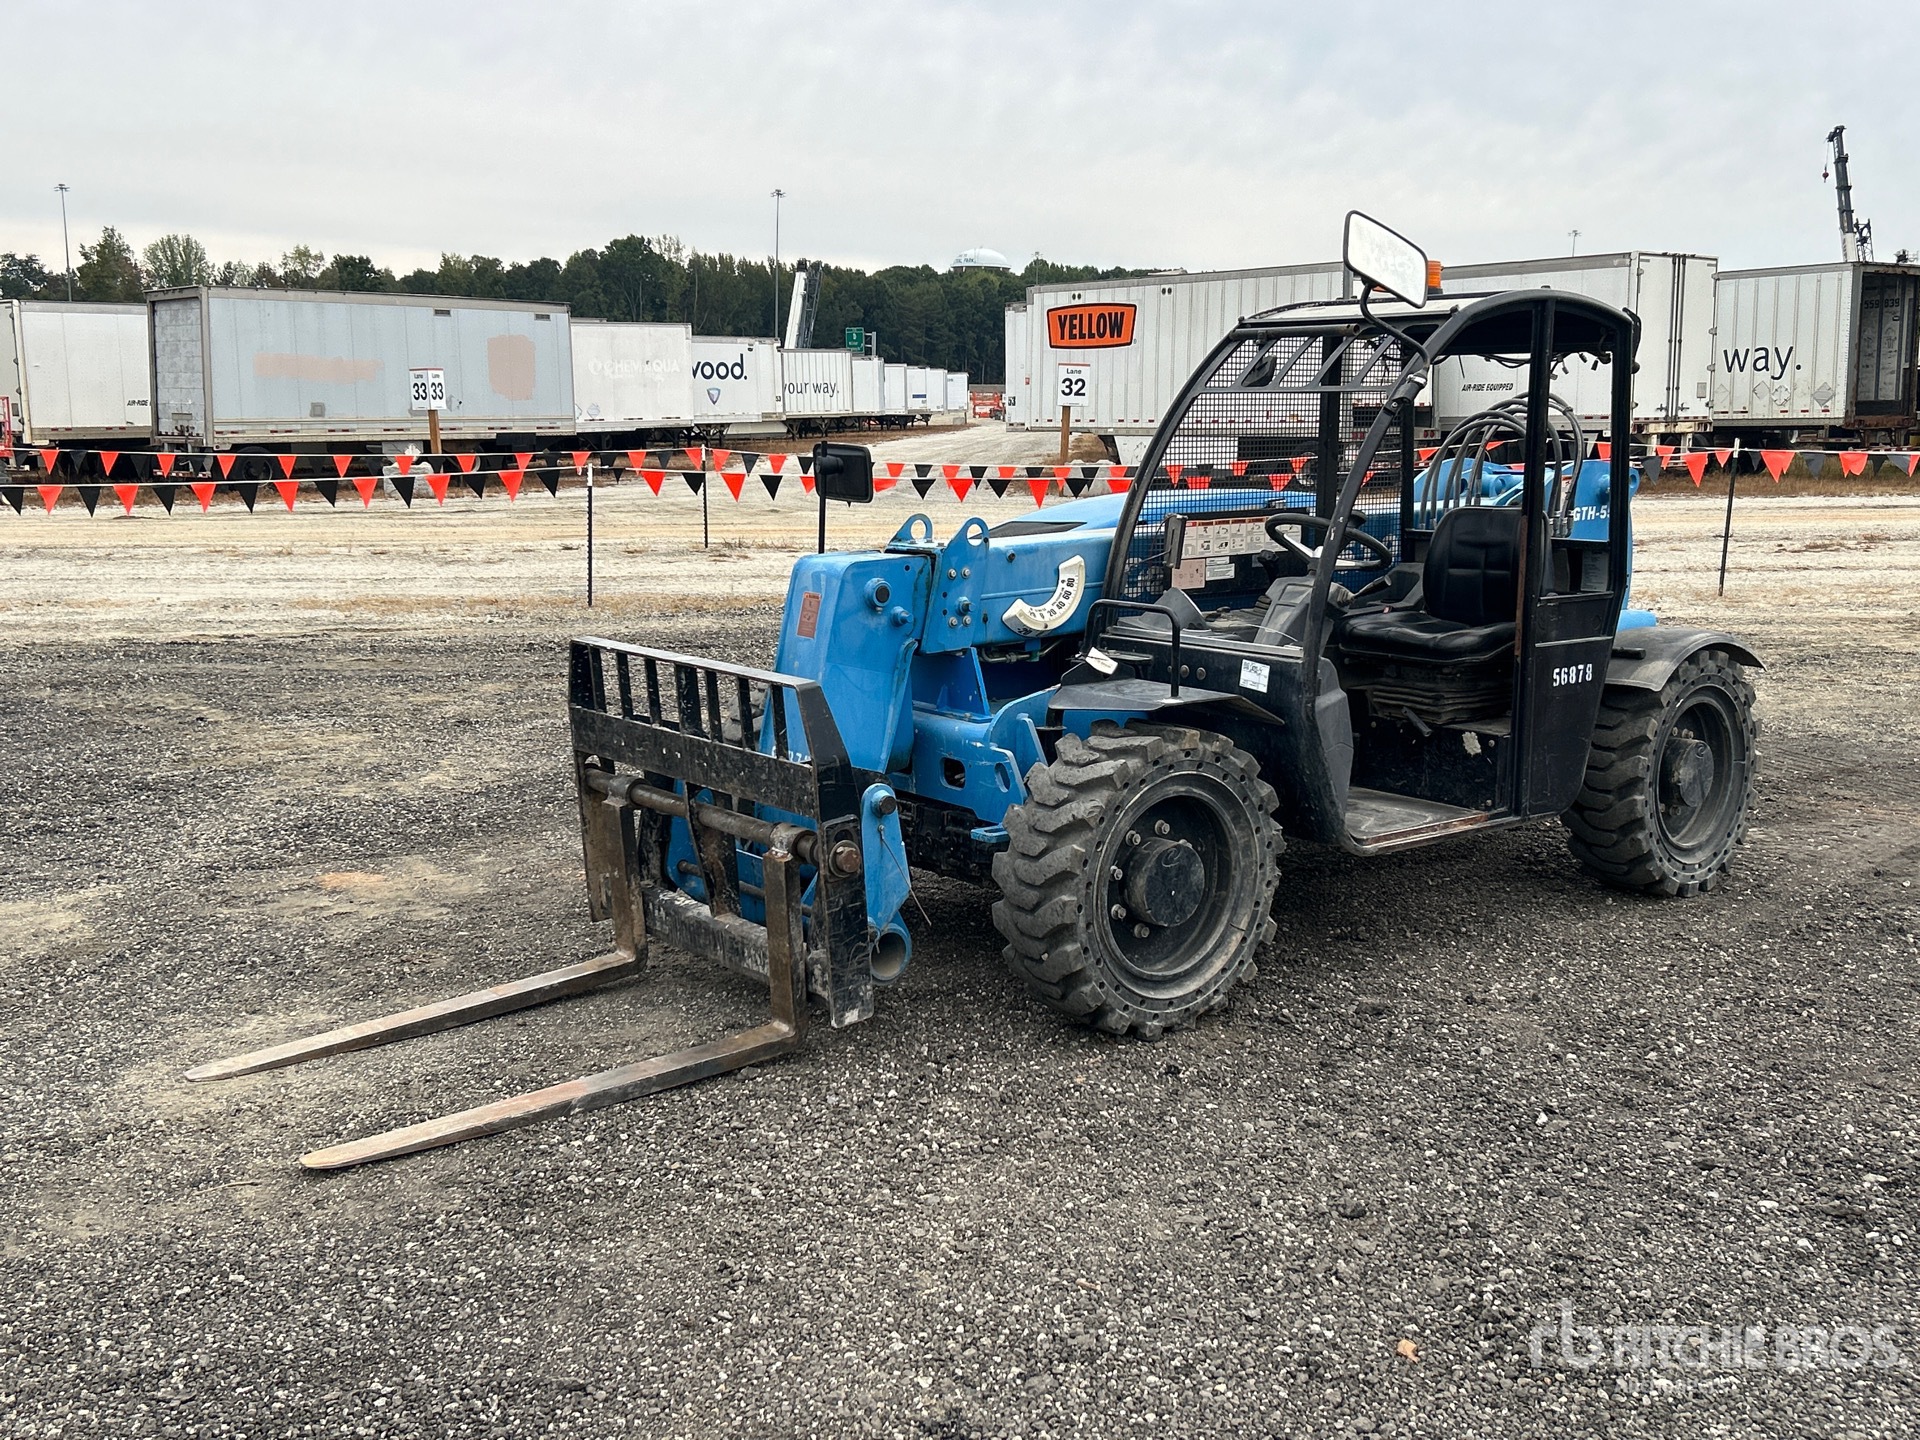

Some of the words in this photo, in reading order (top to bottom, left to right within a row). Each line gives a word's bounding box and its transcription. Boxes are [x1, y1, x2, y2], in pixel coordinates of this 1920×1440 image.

[1057, 311, 1125, 340] YELLOW
[1723, 345, 1801, 380] way.
[412, 382, 428, 400] 33
[430, 382, 444, 400] 33
[812, 382, 840, 398] way.
[1060, 377, 1086, 397] 32
[1486, 382, 1514, 391] EQUIPPED
[1066, 577, 1075, 588] 80
[1552, 663, 1593, 687] 56878
